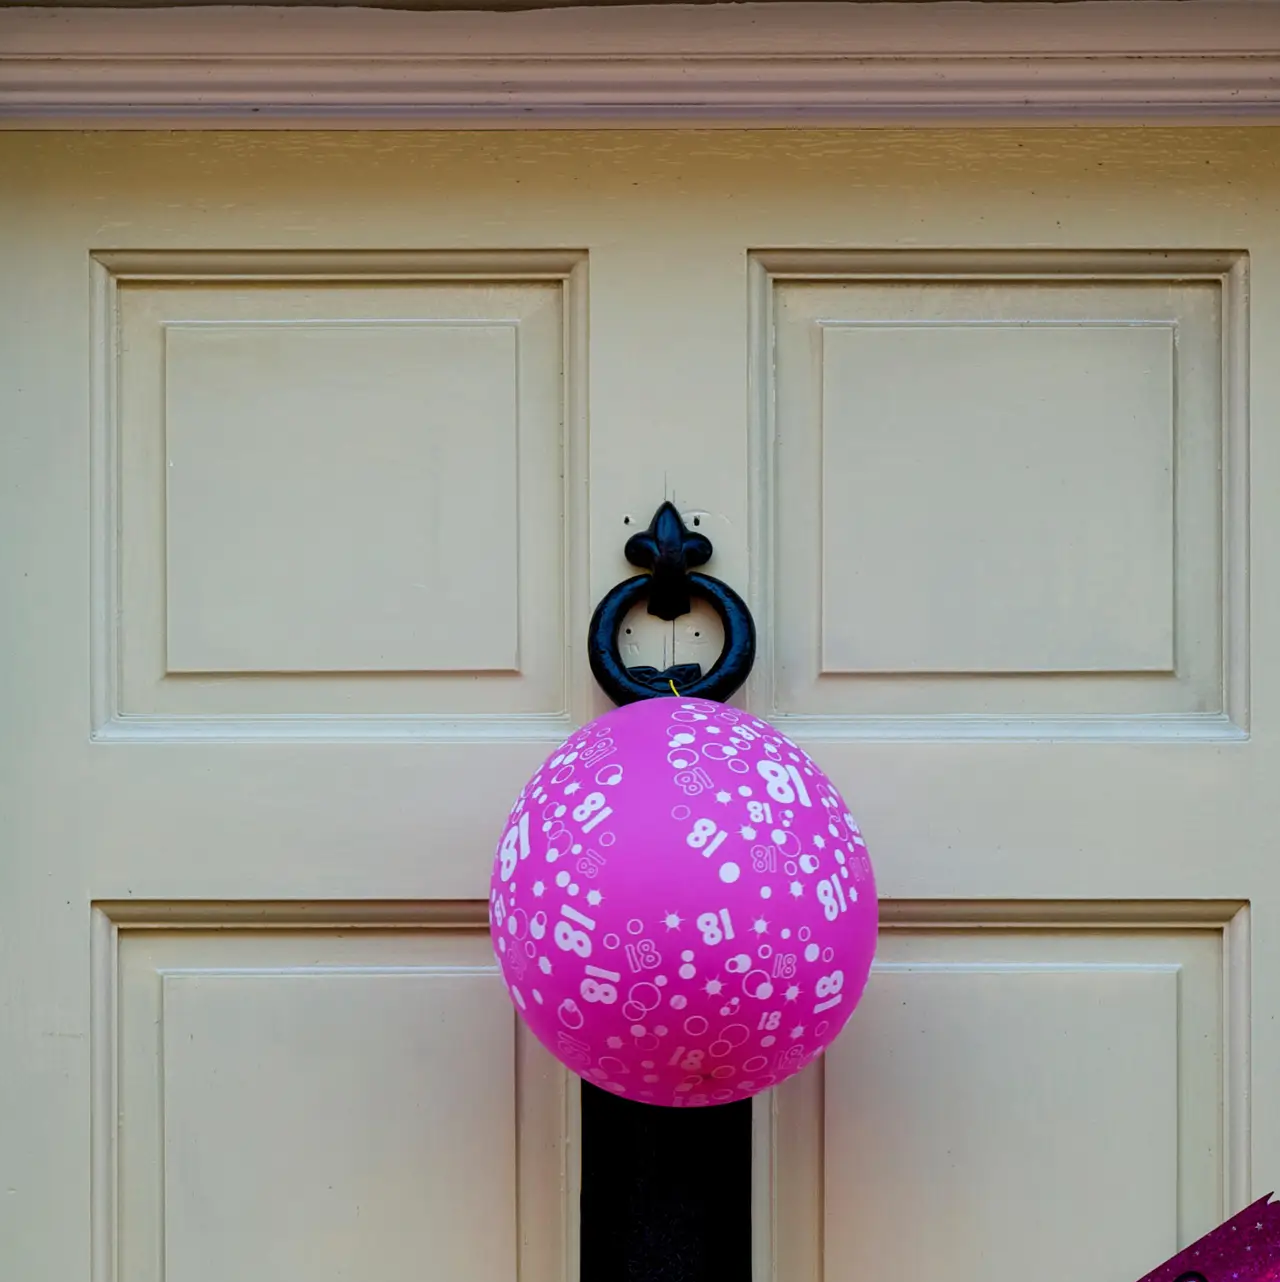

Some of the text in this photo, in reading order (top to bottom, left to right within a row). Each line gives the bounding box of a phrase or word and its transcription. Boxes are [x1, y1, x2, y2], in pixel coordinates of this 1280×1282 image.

[580, 737, 618, 769] 18
[673, 766, 715, 796] 18
[756, 759, 813, 808] 18
[572, 791, 614, 825] 18
[746, 800, 774, 825] 18
[500, 811, 531, 882] 18
[685, 817, 729, 859] 18
[575, 848, 607, 879] 18
[750, 844, 778, 874] 18
[816, 873, 848, 922] 18
[553, 903, 597, 959] 18
[696, 907, 736, 946] 18
[625, 938, 663, 974] 18
[771, 953, 798, 979] 18
[579, 964, 622, 1005] 18
[815, 969, 845, 1015] 18
[757, 1010, 783, 1031] 18
[667, 1045, 706, 1071] 18
